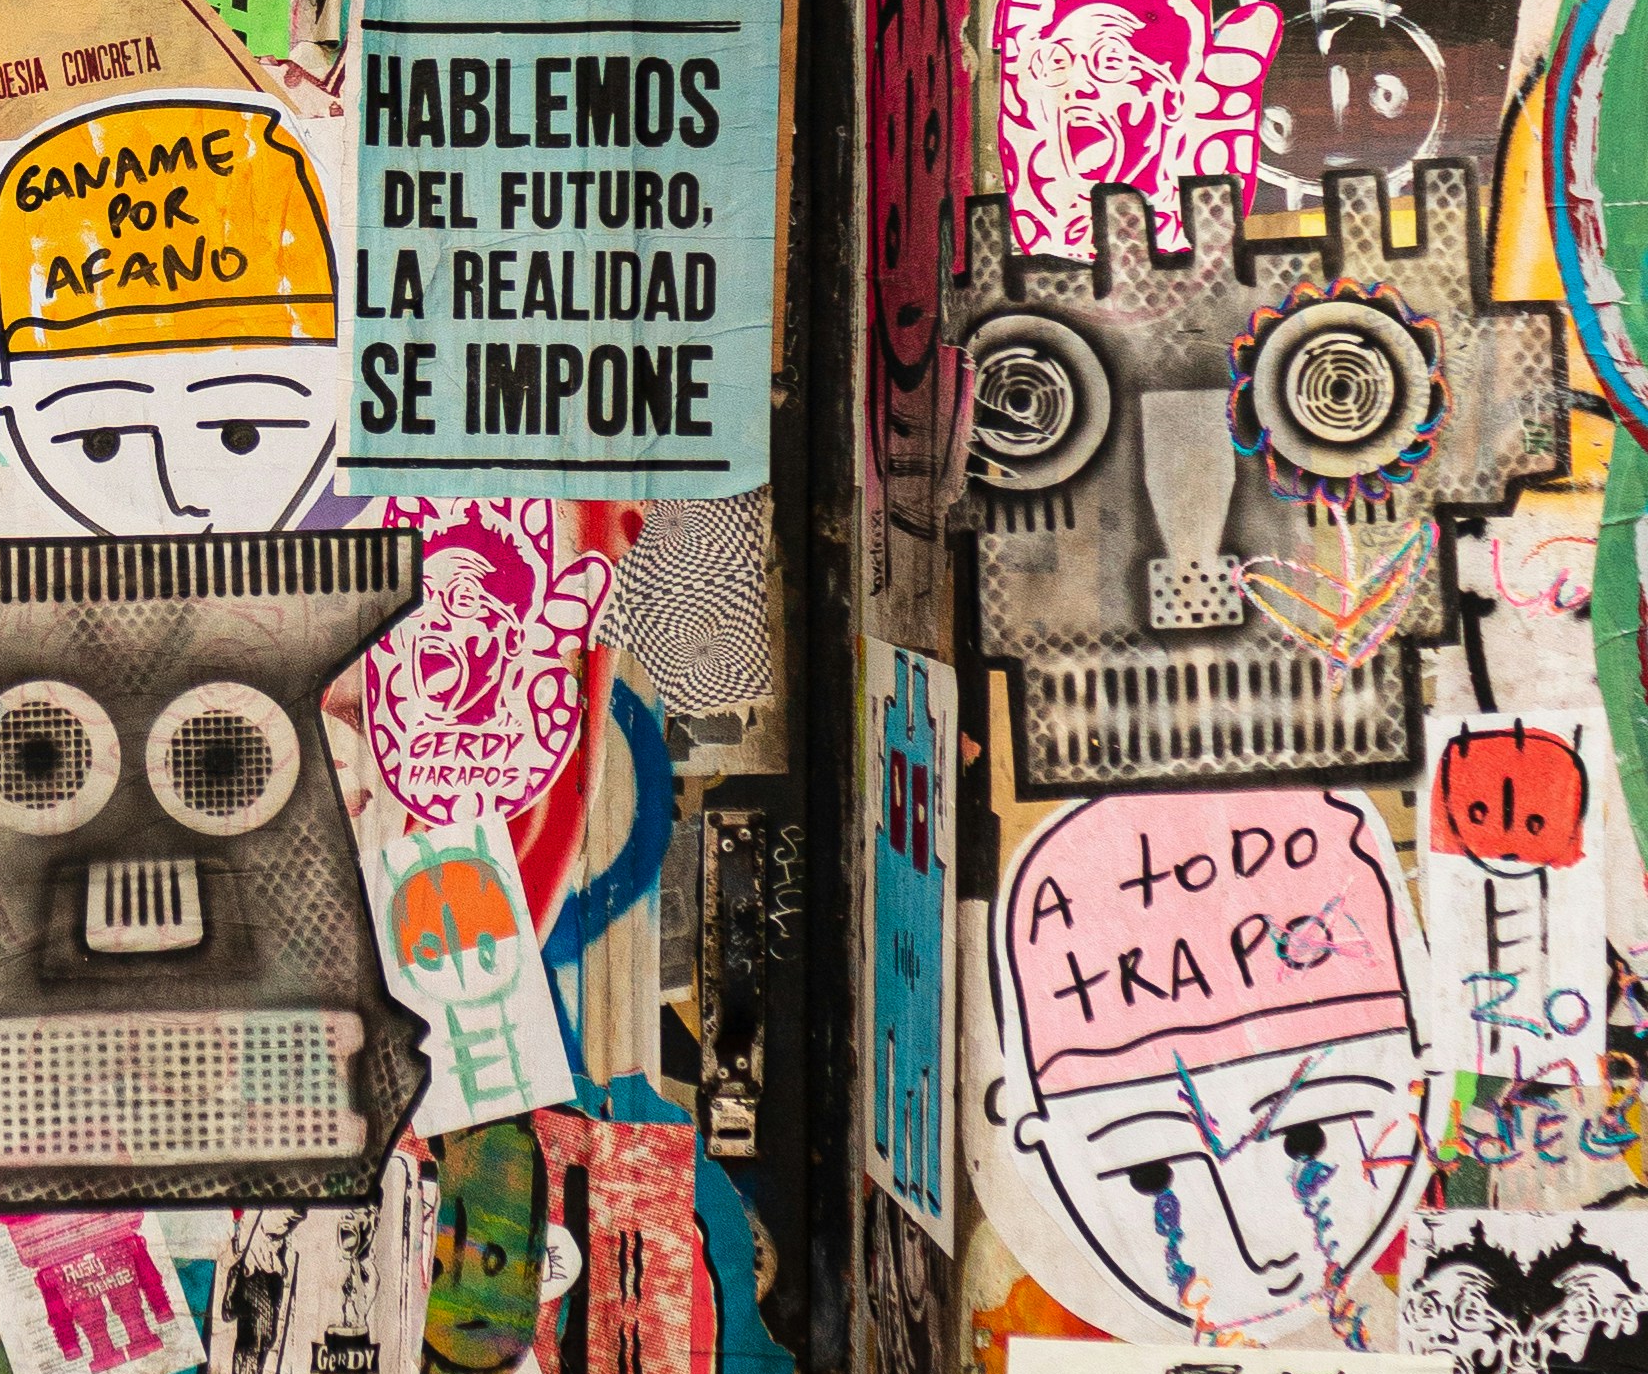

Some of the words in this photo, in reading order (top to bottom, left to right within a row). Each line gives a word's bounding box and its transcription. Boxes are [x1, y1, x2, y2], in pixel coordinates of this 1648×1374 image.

[61, 36, 162, 86] CONCRETA
[365, 54, 720, 149] HABLEMOS
[107, 186, 200, 239] POR
[383, 171, 478, 229] DEL
[501, 171, 713, 229] FUTURO,
[45, 237, 248, 300] AFANO
[356, 248, 424, 320] LA
[453, 250, 717, 322] REALIDAD
[360, 342, 436, 435] SE
[466, 343, 714, 437] IMPONE
[409, 765, 519, 788] HARAPOS
[410, 732, 525, 764] GERDY
[1028, 876, 1073, 945] A
